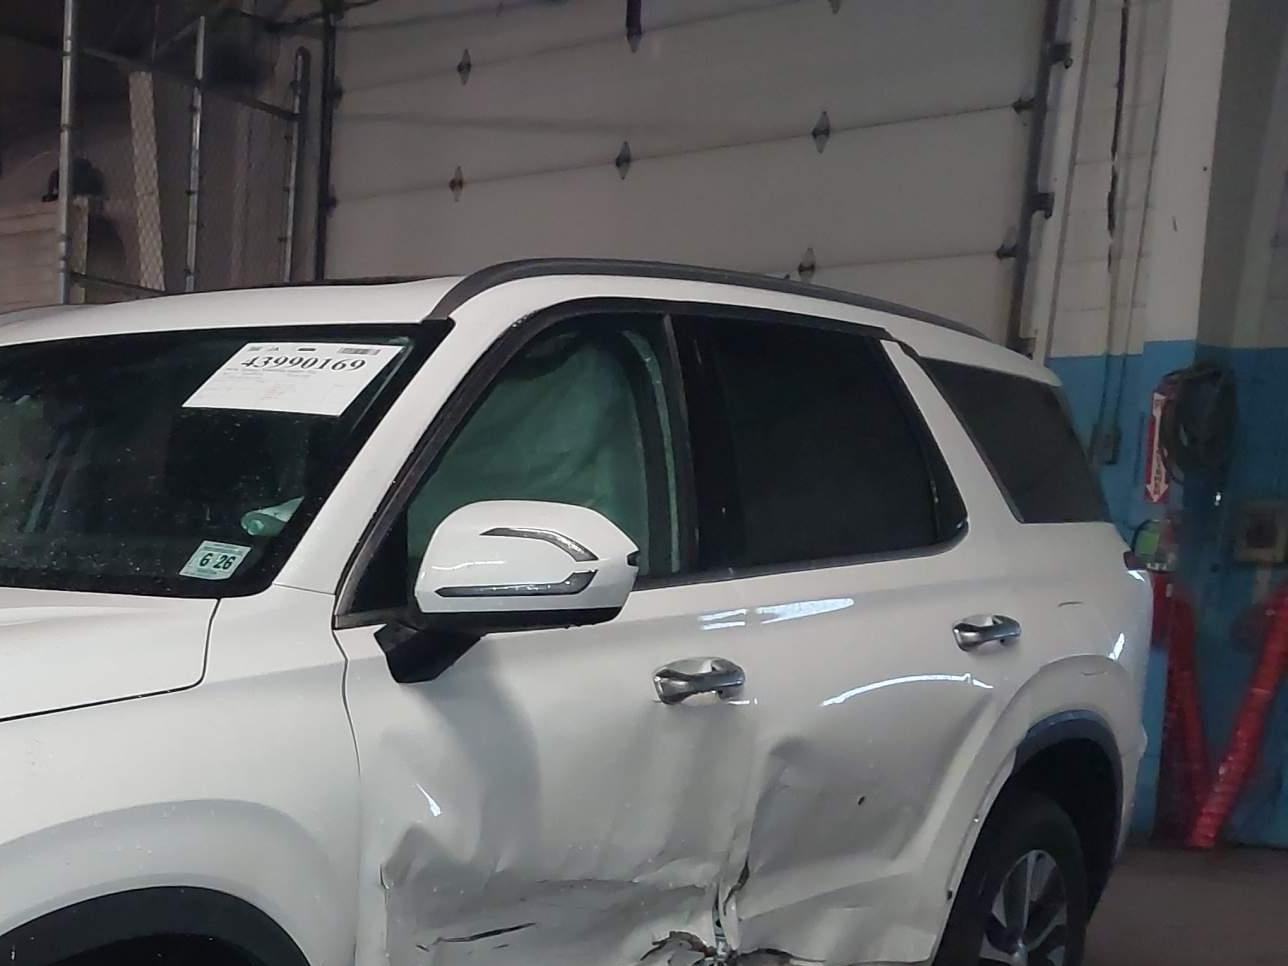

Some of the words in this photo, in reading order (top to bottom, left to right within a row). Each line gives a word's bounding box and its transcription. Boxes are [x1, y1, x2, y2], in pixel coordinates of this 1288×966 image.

[241, 355, 367, 372] 43990169
[199, 552, 213, 567] 6
[213, 554, 238, 570] 26
